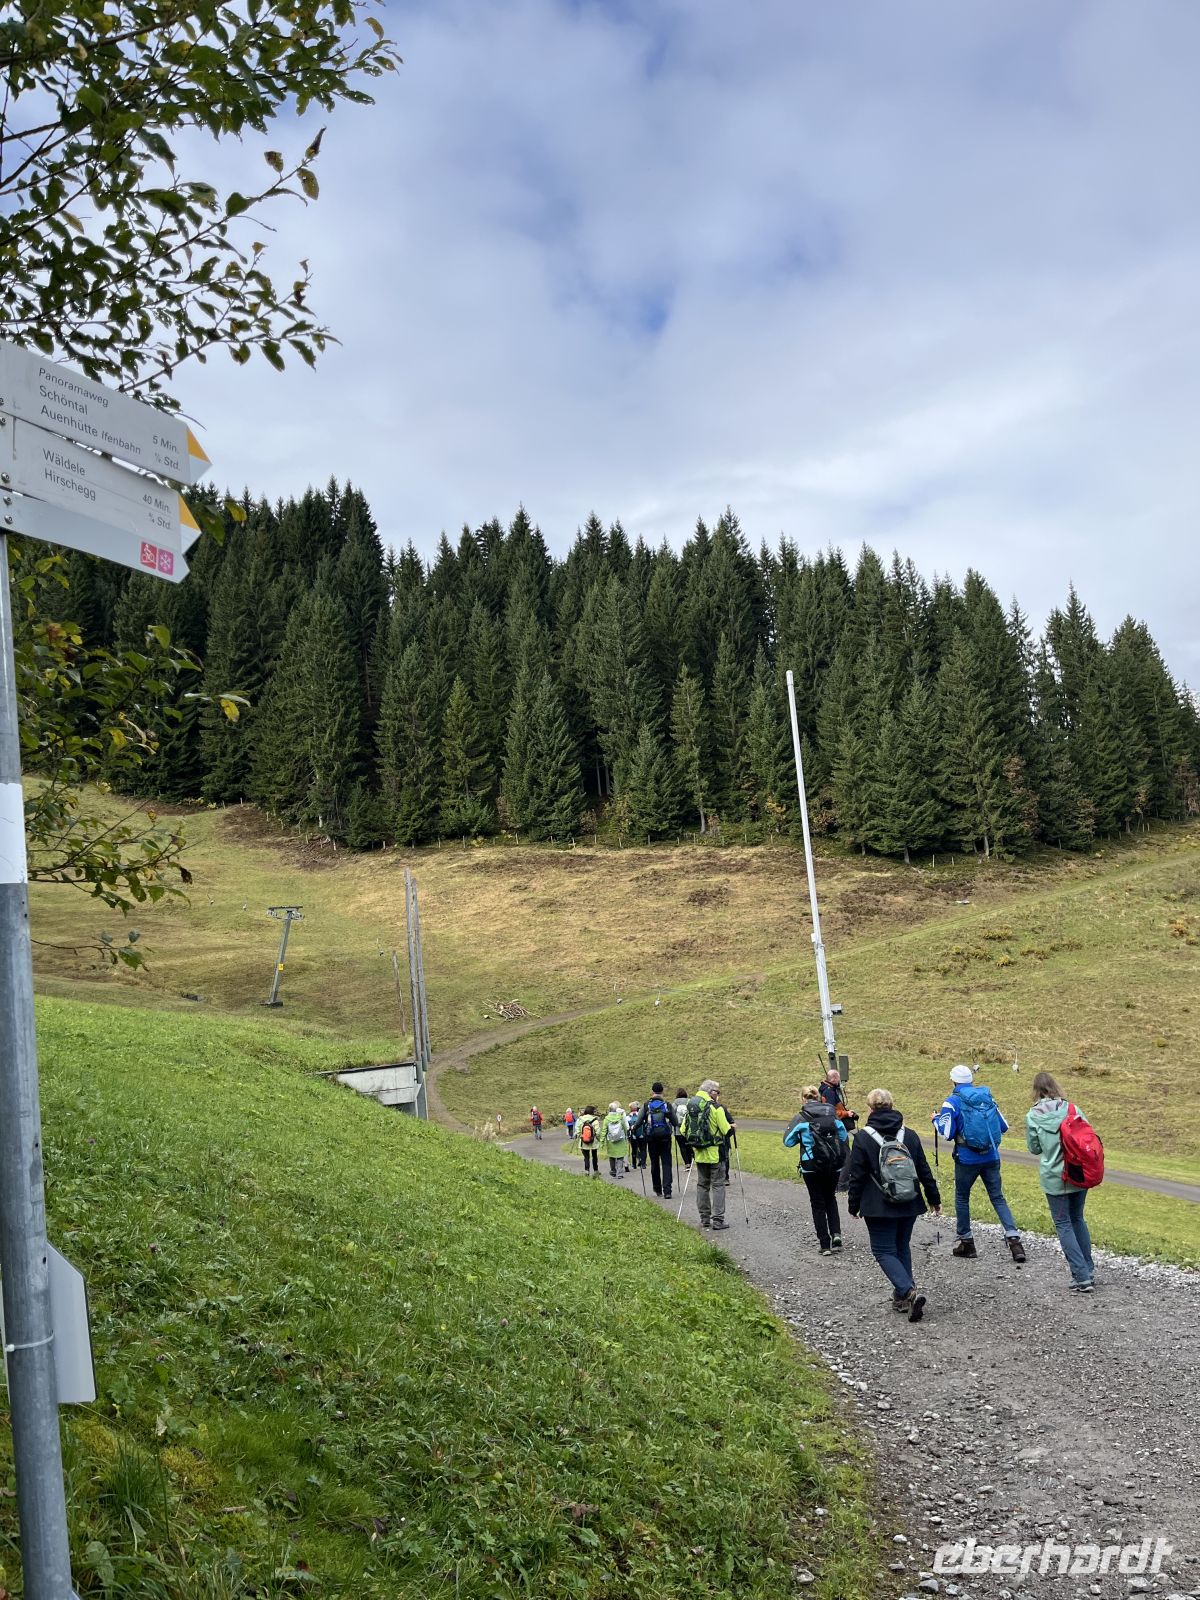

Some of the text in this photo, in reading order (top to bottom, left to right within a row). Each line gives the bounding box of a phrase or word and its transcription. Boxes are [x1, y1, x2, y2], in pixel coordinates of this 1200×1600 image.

[39, 368, 108, 407] Panoramaweg
[39, 385, 88, 415] Schöntal
[40, 405, 140, 455] Auenhütte Ifenbahn
[152, 435, 158, 445] 5
[42, 447, 86, 476] Wäldele
[44, 467, 96, 502] Hirschegg
[142, 494, 152, 505] 40
